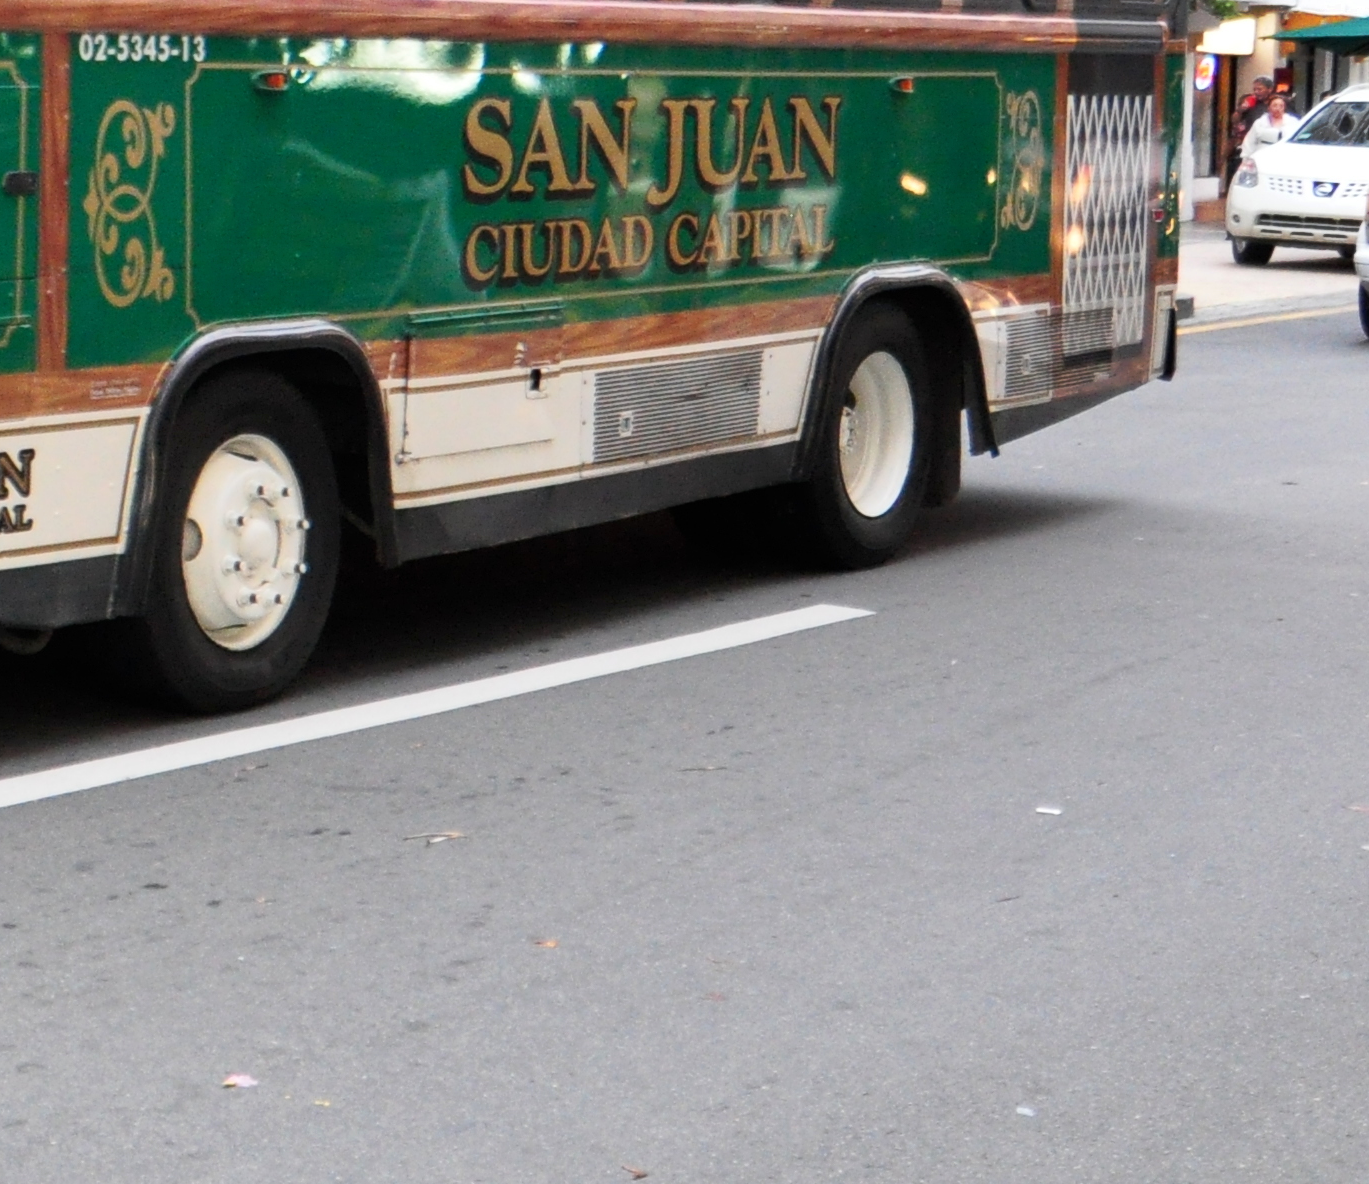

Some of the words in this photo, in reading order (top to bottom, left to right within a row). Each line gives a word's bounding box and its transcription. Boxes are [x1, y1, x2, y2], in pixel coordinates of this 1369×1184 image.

[78, 33, 206, 62] 02-5345-13
[462, 94, 638, 205] SAN
[645, 95, 842, 207] JUAN
[461, 215, 655, 291] CIUDAD
[665, 203, 836, 273] CAPITAL
